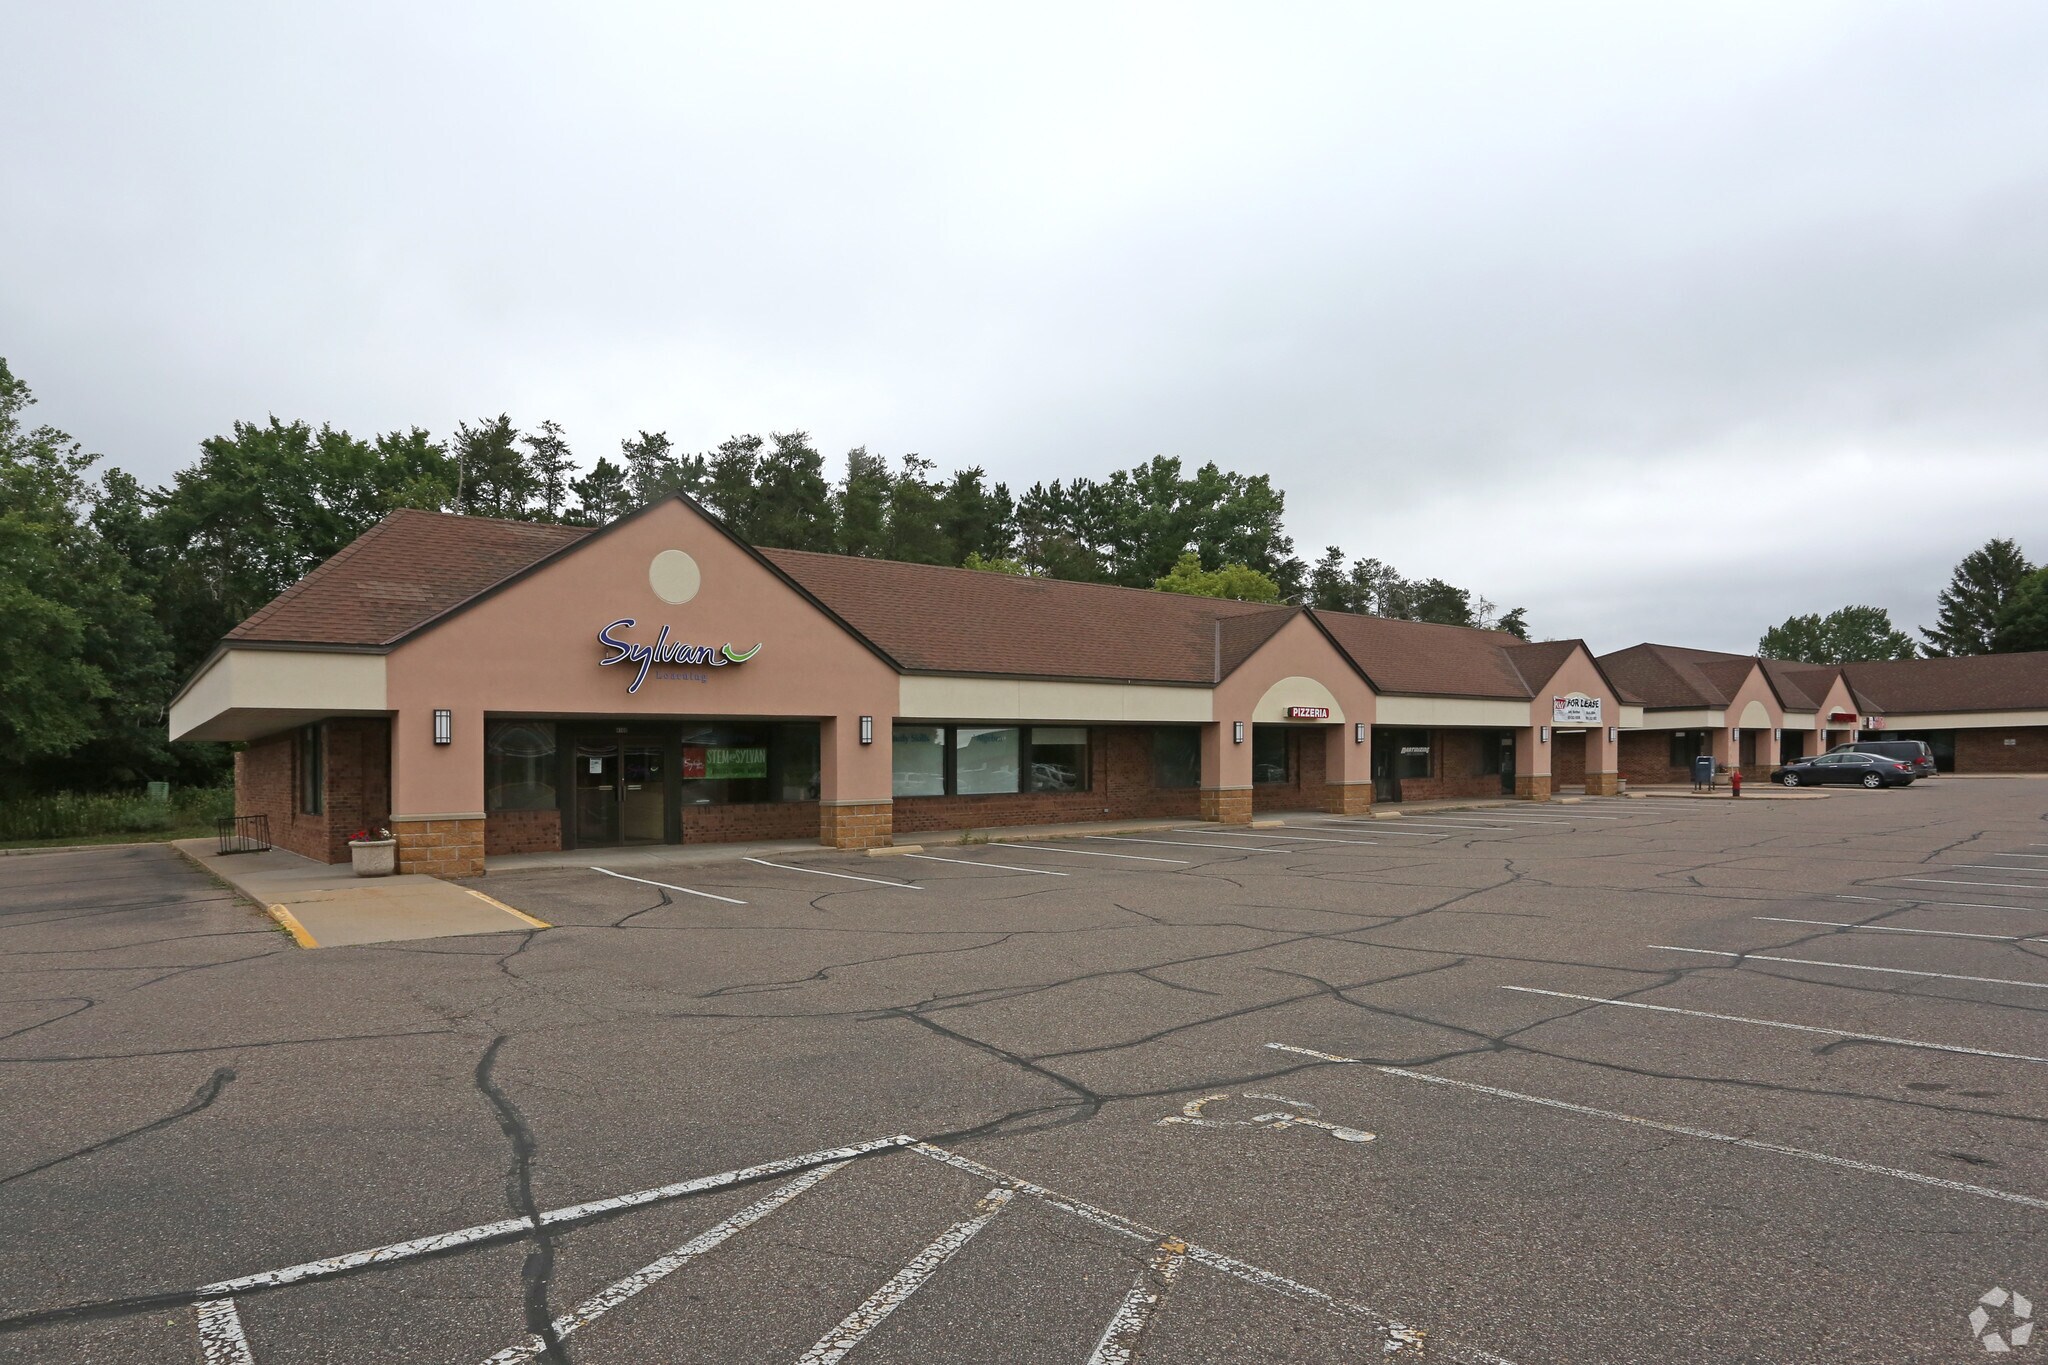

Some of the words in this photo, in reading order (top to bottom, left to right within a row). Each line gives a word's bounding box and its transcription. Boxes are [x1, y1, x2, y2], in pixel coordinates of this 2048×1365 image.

[599, 618, 728, 694] Sylvan
[1567, 699, 1579, 707] FOR
[1580, 700, 1599, 708] LEASE
[1292, 707, 1328, 718] PIZZERIA
